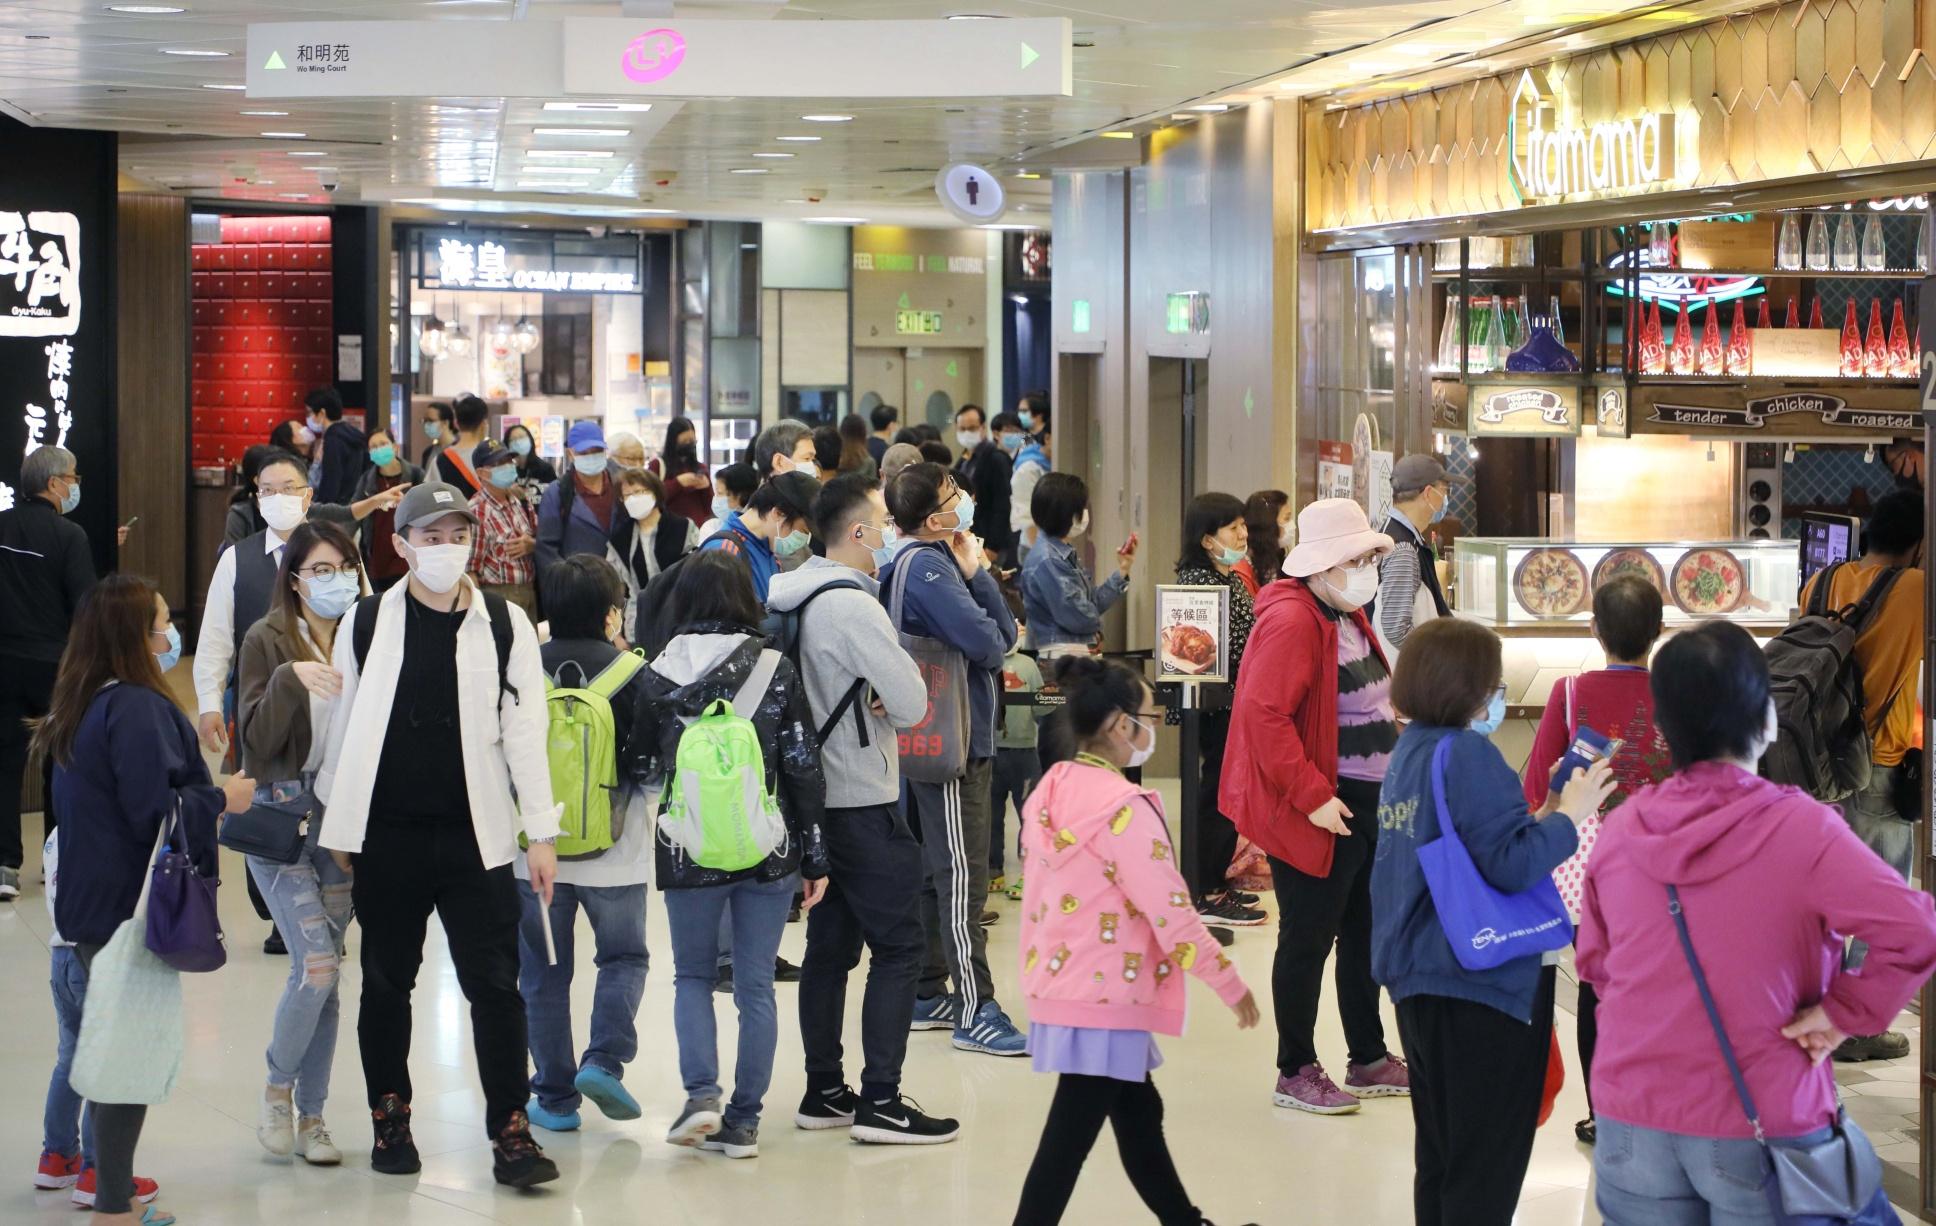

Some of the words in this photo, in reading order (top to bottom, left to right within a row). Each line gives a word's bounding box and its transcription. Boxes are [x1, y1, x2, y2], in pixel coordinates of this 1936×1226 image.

[297, 44, 350, 62] 和明苑
[297, 65, 307, 73] Wo
[308, 65, 325, 74] Ming
[327, 64, 347, 72] Court
[512, 270, 570, 291] OCEAN
[11, 306, 52, 317] Gyu-Kaku
[1674, 409, 1727, 424] tender
[1767, 397, 1824, 413] chicken
[1851, 413, 1913, 428] roasted
[1171, 608, 1208, 622] 等候區
